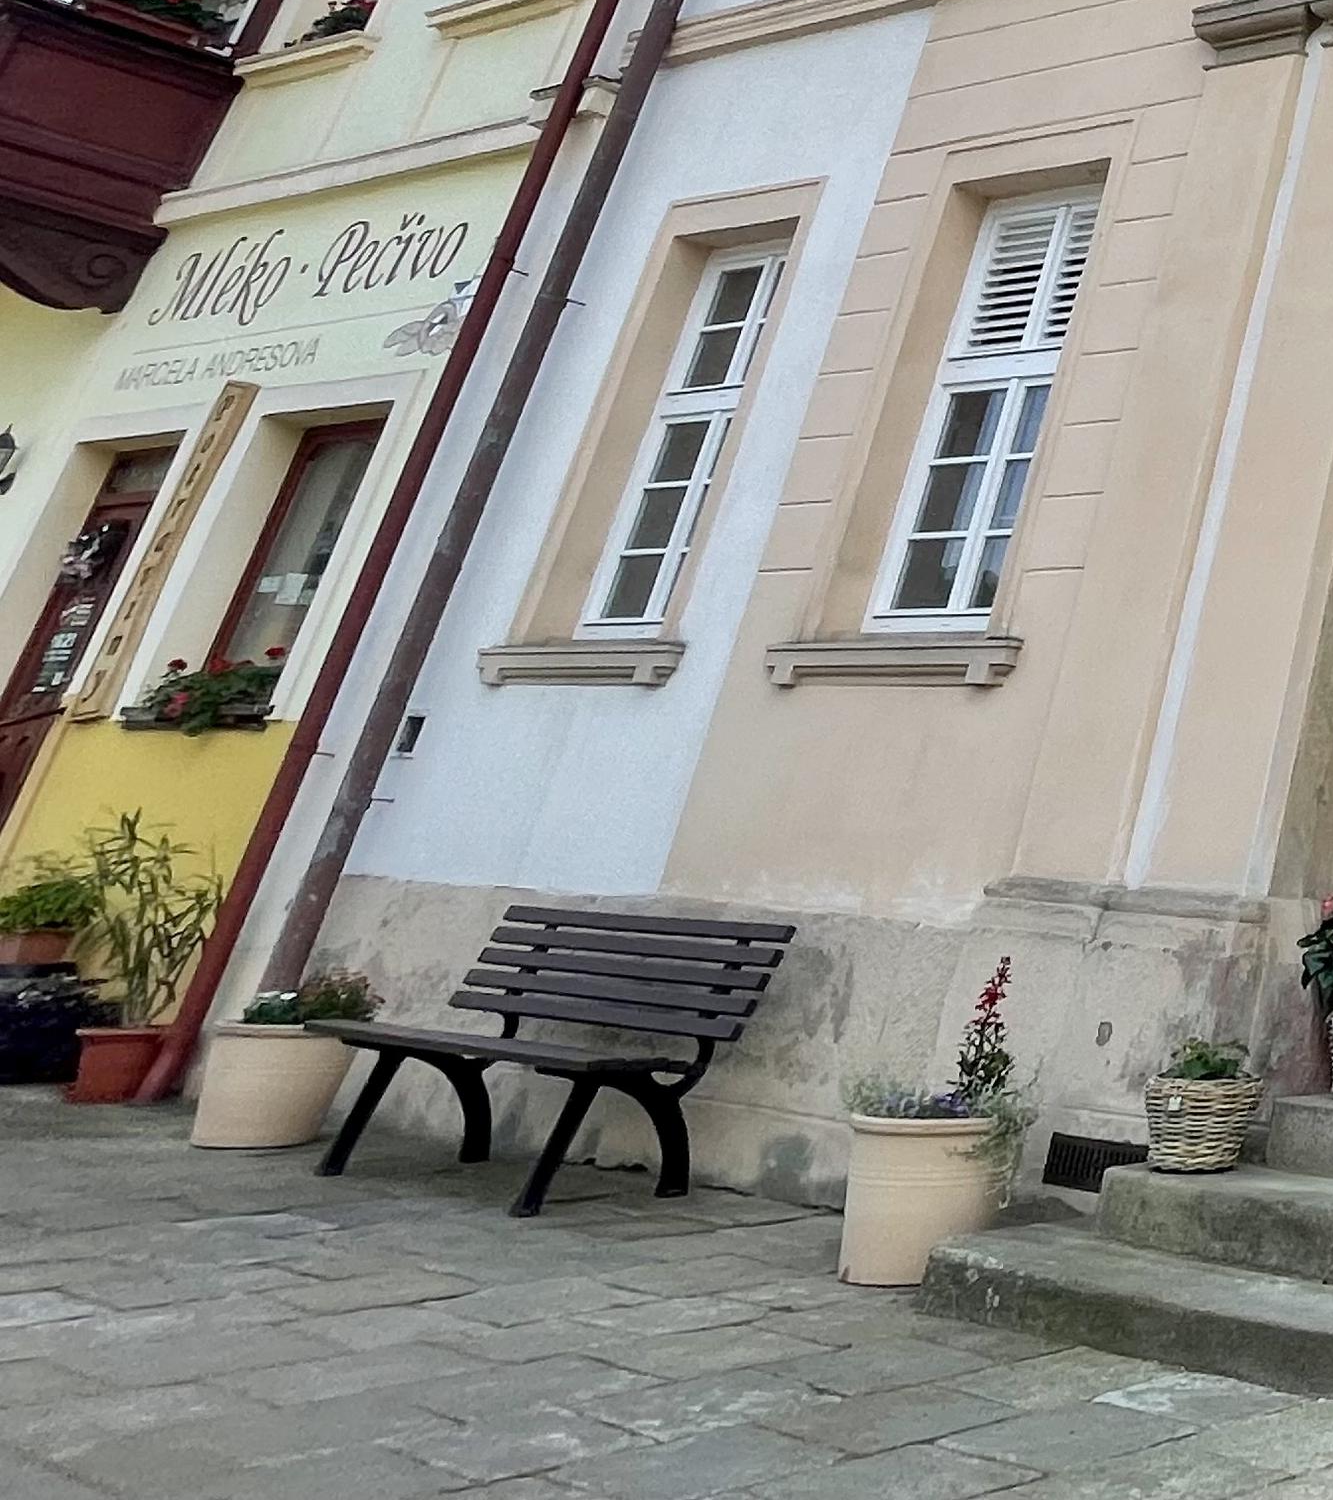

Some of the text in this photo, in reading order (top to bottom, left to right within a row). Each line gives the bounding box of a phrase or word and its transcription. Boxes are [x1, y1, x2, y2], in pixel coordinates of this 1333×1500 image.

[147, 211, 469, 327] Mléko Pečivo
[114, 336, 323, 392] MARCELA ANDRESOVÁ
